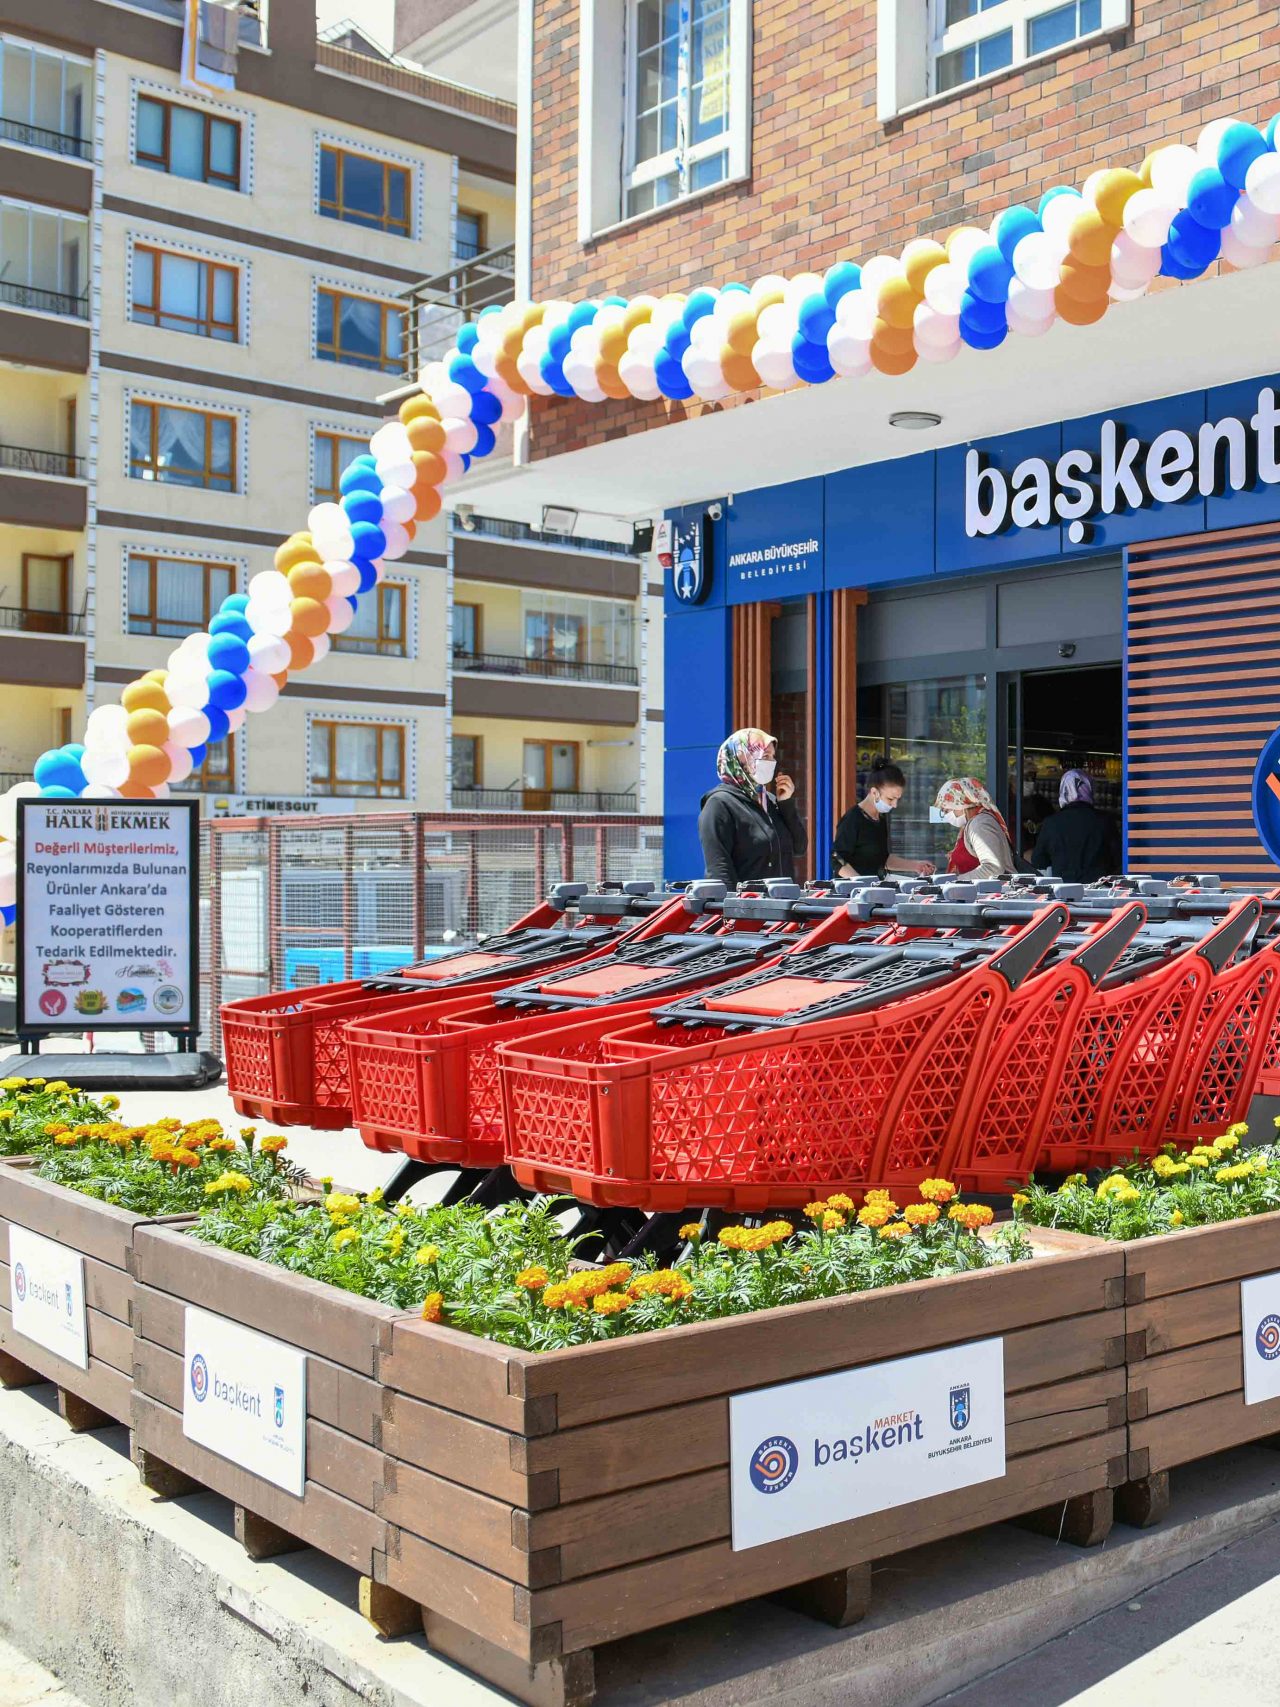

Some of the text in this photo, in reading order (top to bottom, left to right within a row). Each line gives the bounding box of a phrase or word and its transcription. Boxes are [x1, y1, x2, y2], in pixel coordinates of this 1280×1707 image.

[729, 538, 819, 567] ANKARA BÜYÜKŞEHİR
[740, 561, 807, 580] BELEDİYESİ
[62, 808, 92, 816] ANKARA
[246, 799, 318, 812] ETİMESGUT
[45, 816, 171, 830] HALK EKMEK
[35, 842, 179, 858] Değerli Müşterilerimiz,
[26, 862, 187, 877] Reyonlarımızda Bulunan
[46, 881, 97, 896] Ürünler
[49, 904, 164, 919] Faaliyet Gösteren
[51, 924, 163, 939] Kooperatiflerden
[36, 945, 177, 958] Tedarik Edilmektedir.
[874, 1410, 914, 1429] MARKET
[814, 1413, 923, 1467] başkent
[949, 1434, 972, 1445] ANKARA
